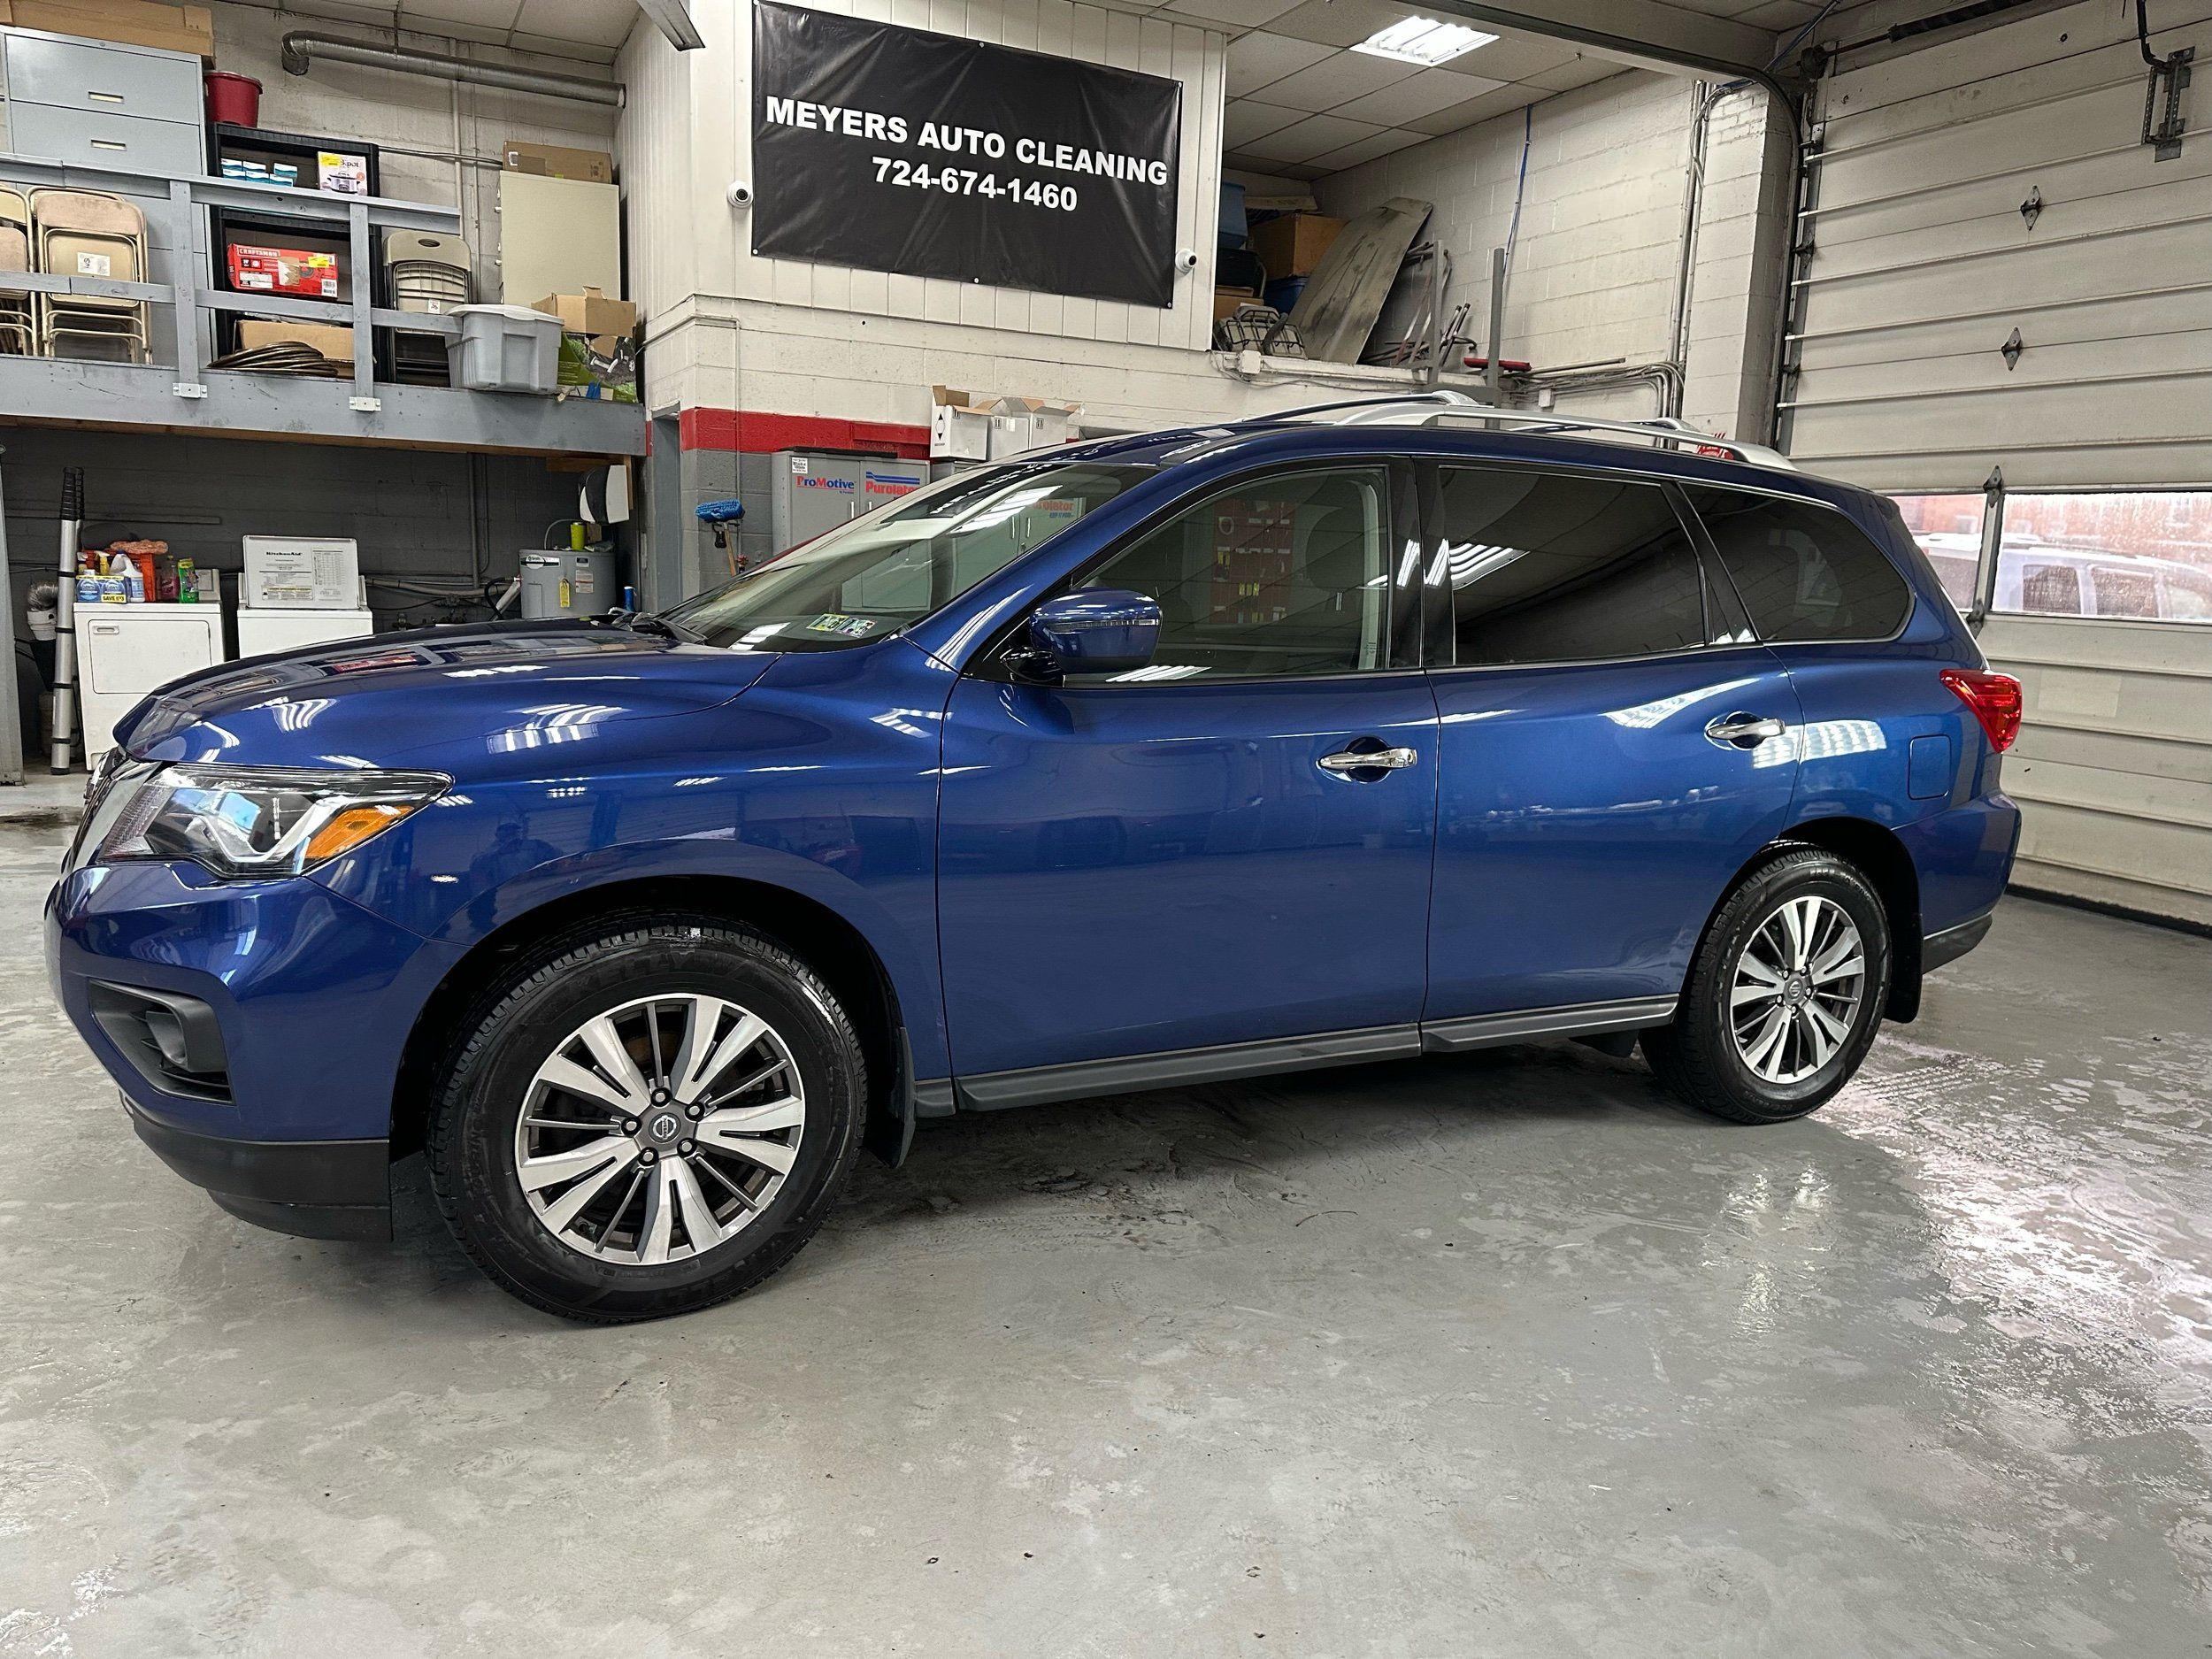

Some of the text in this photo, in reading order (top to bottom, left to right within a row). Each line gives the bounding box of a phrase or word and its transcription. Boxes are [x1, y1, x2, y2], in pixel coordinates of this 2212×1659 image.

[766, 96, 1168, 185] MEYERS AUTO CLEANING
[872, 157, 1078, 211] 724-674-1460
[239, 248, 278, 257] CRAFTSMAN
[797, 476, 855, 488] ProMotive
[865, 481, 916, 495] Purolato
